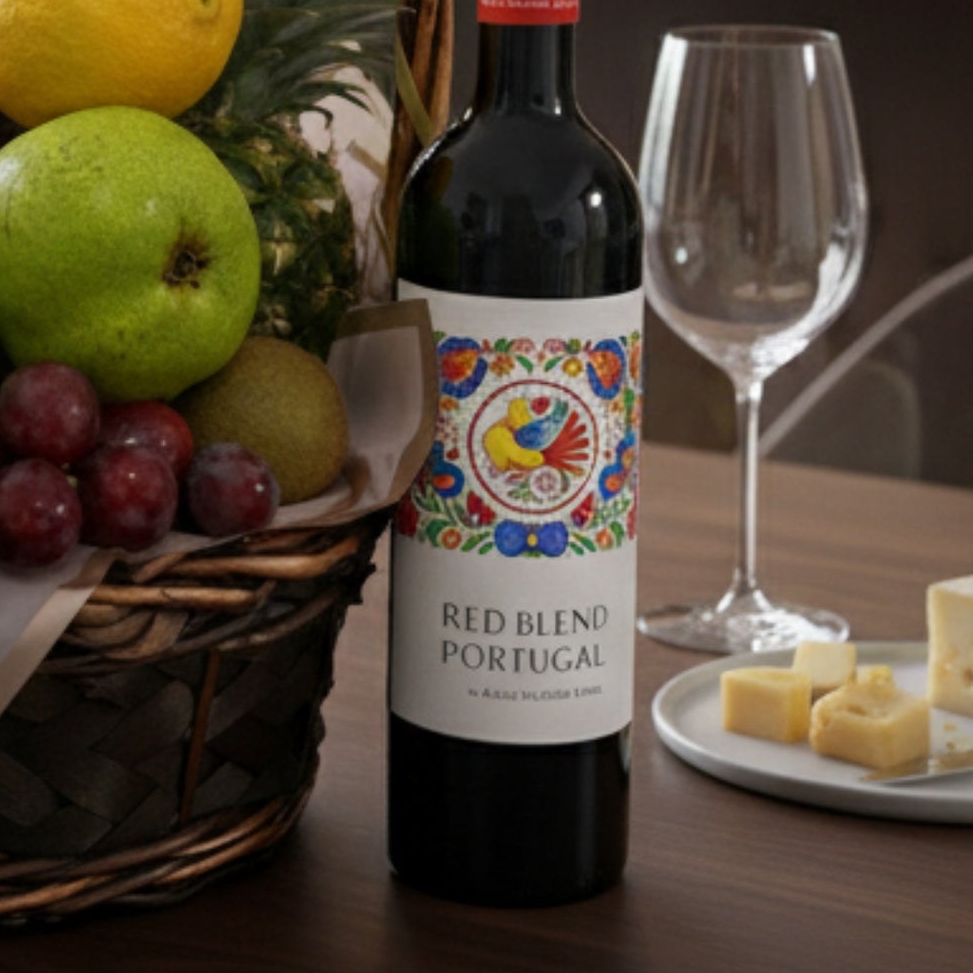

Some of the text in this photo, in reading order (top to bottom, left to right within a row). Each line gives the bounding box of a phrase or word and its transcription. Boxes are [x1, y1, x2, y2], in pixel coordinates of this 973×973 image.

[442, 602, 609, 637] RED BLEND
[441, 640, 606, 674] PORTUGAL
